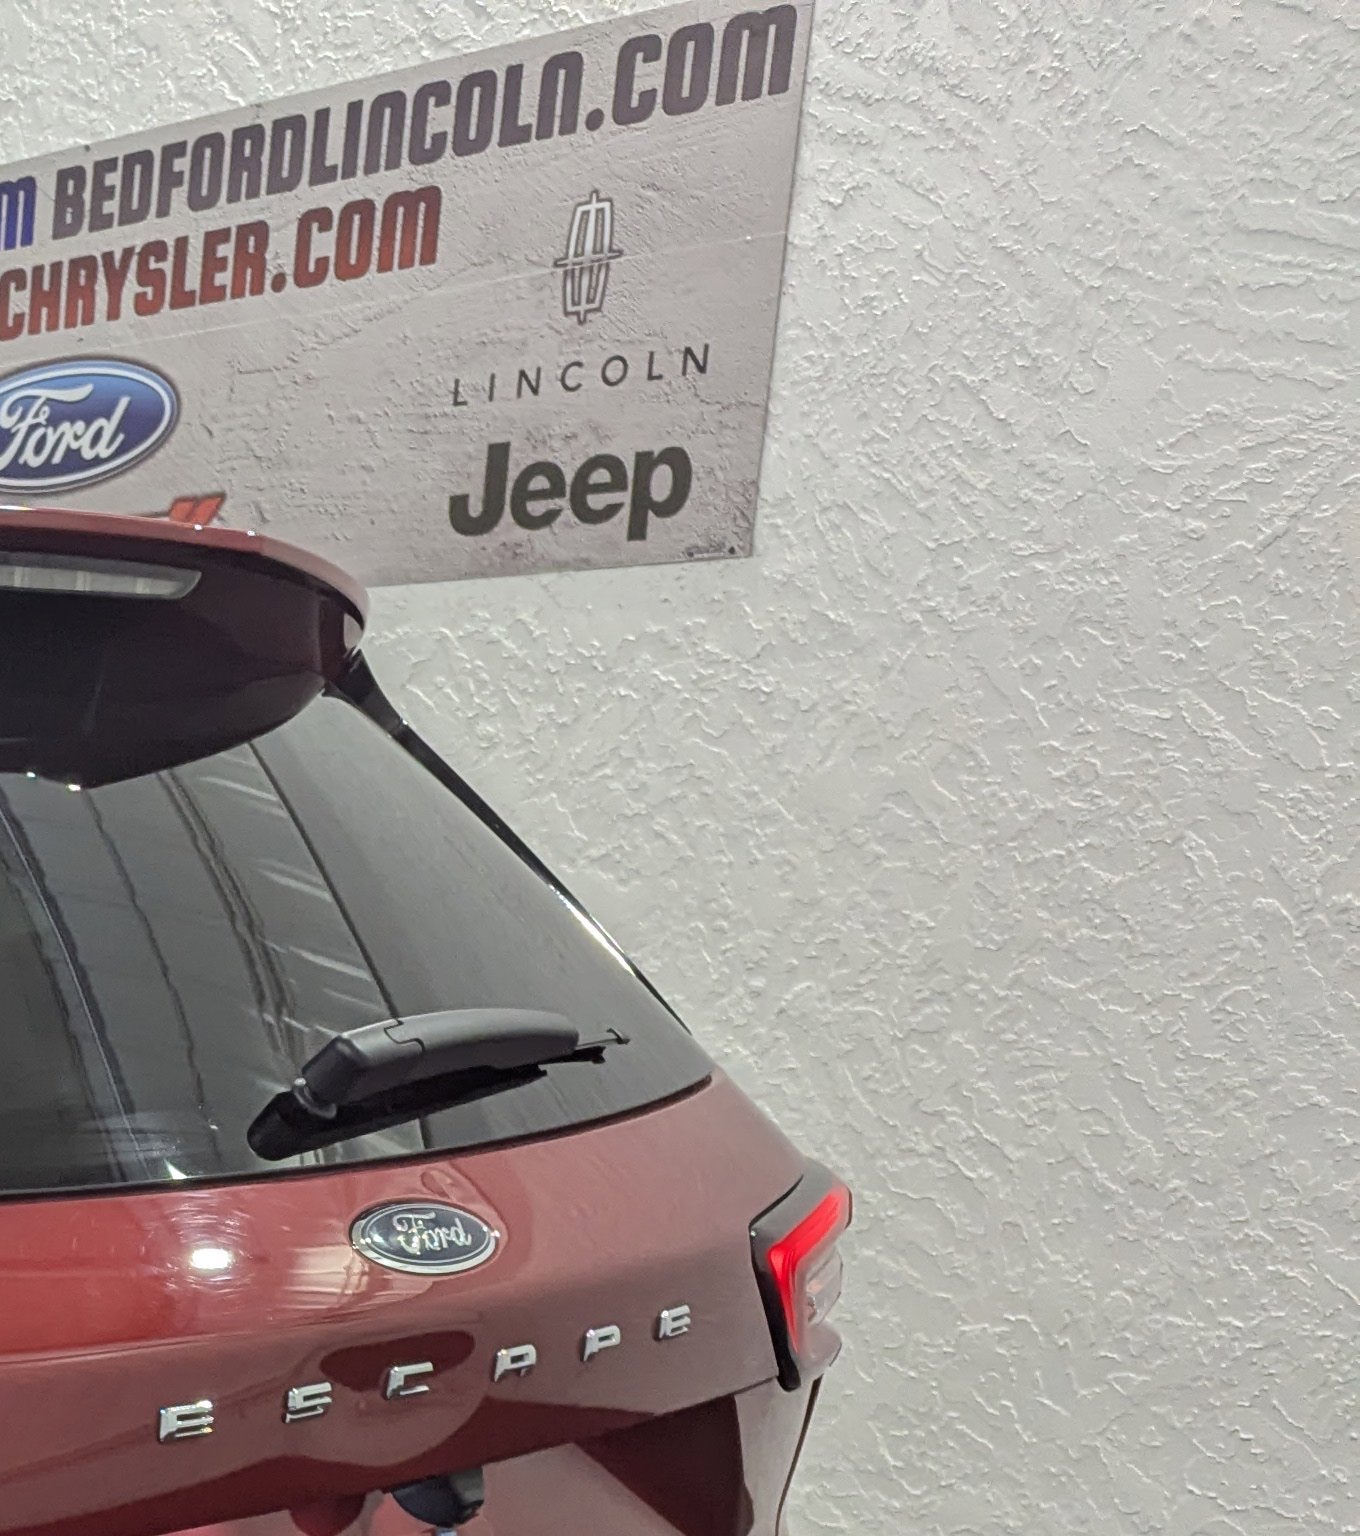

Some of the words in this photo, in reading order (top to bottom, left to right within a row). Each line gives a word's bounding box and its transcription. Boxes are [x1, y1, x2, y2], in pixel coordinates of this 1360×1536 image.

[52, 4, 798, 240] BEDFORDLINCOLN.COM
[452, 343, 709, 406] LINCOLN
[448, 441, 693, 541] Jeep
[392, 1211, 472, 1255] Ford
[157, 1304, 691, 1442] ESCAPE
